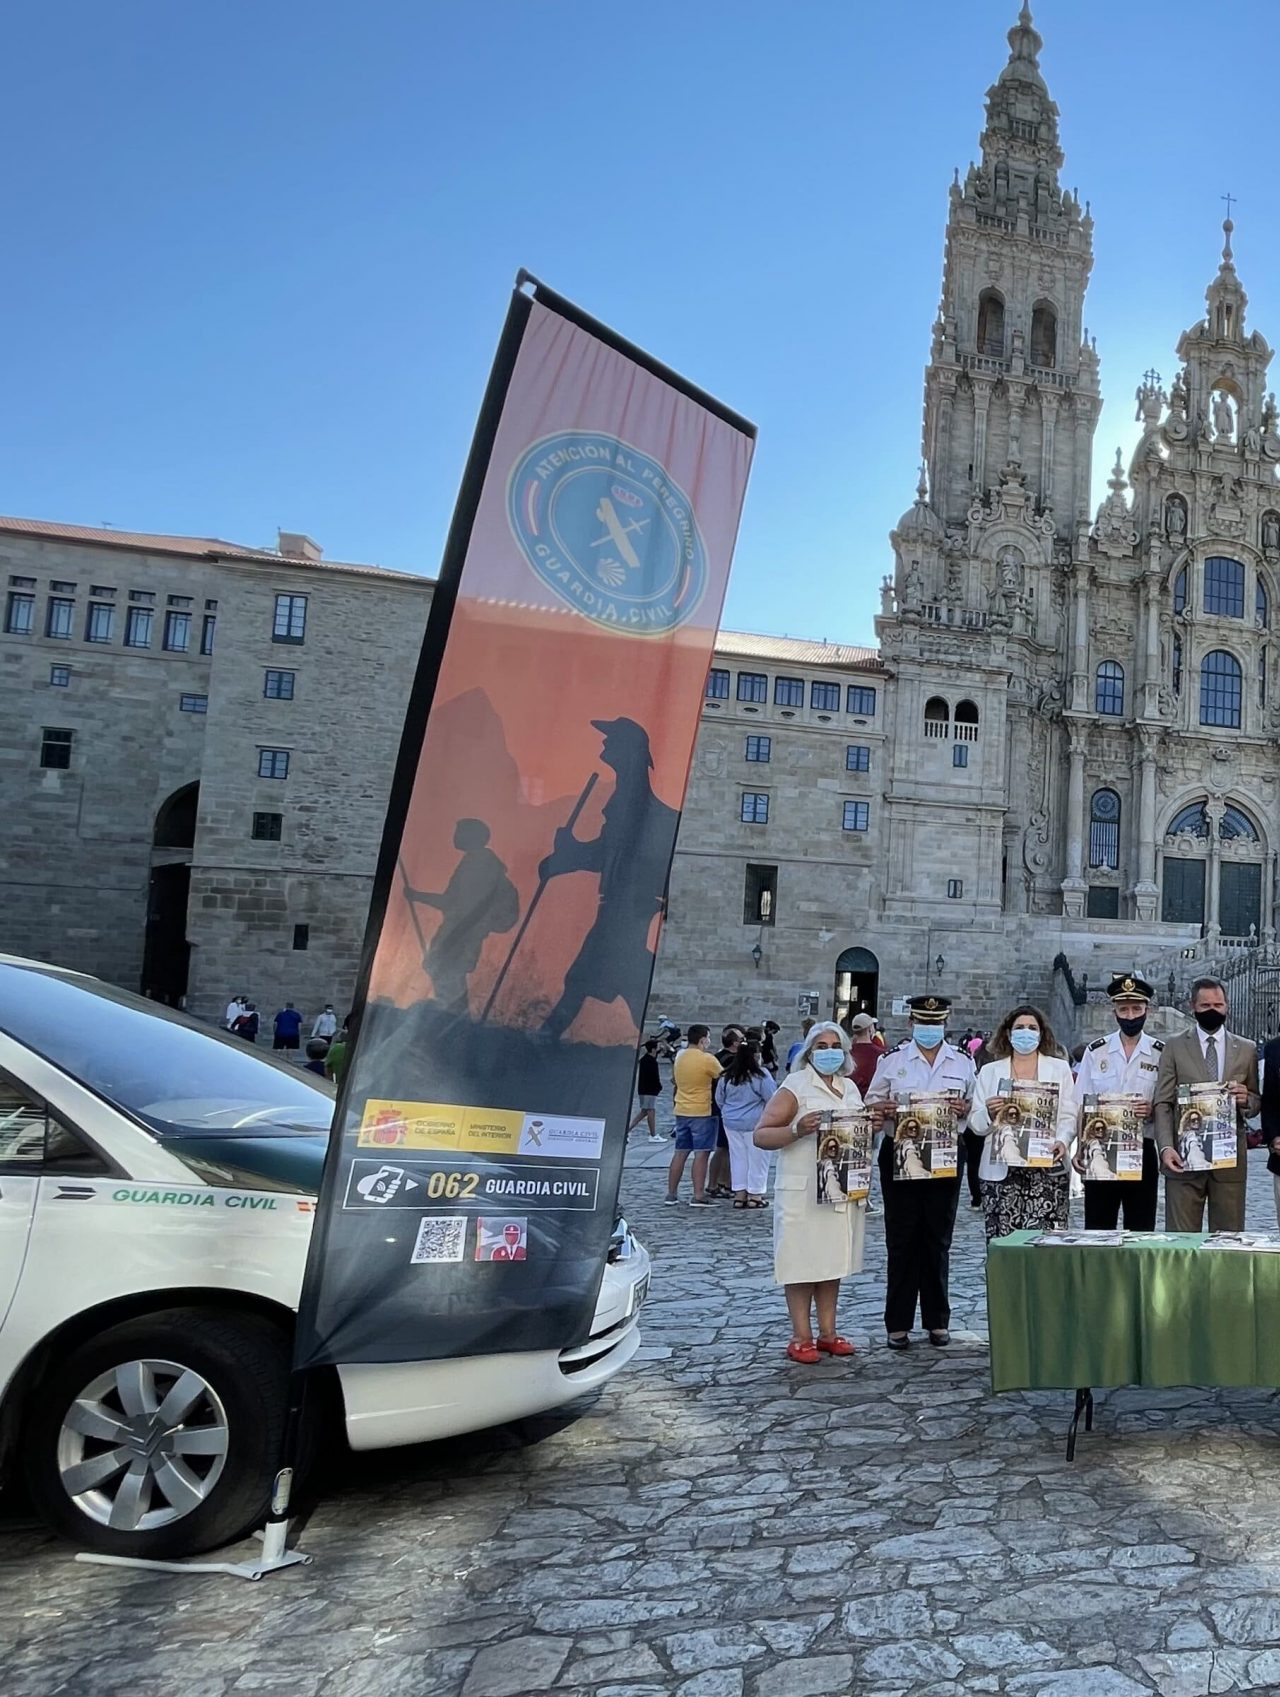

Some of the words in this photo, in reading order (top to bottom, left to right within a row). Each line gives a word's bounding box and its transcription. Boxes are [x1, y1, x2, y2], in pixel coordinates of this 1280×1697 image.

[535, 442, 611, 480] ATENCIÓN
[615, 454, 636, 473] AL
[642, 467, 695, 560] PEREGRINO
[534, 543, 619, 619] GUARDIA
[629, 604, 673, 623] CIVIL
[1037, 1097, 1053, 1106] 016
[1036, 1111, 1053, 1120] 062
[936, 1121, 953, 1129] 062
[1035, 1120, 1050, 1129] 091
[1122, 1123, 1139, 1131] 062
[935, 1131, 952, 1139] 091
[1121, 1132, 1138, 1141] 091
[1218, 1131, 1232, 1140] 112
[936, 1141, 953, 1149] 112
[427, 1171, 480, 1199] 062
[485, 1179, 550, 1195] GUARDIA
[552, 1181, 591, 1196] CIVIL
[112, 1189, 215, 1206] GUARDIA
[224, 1195, 278, 1210] CIVIL
